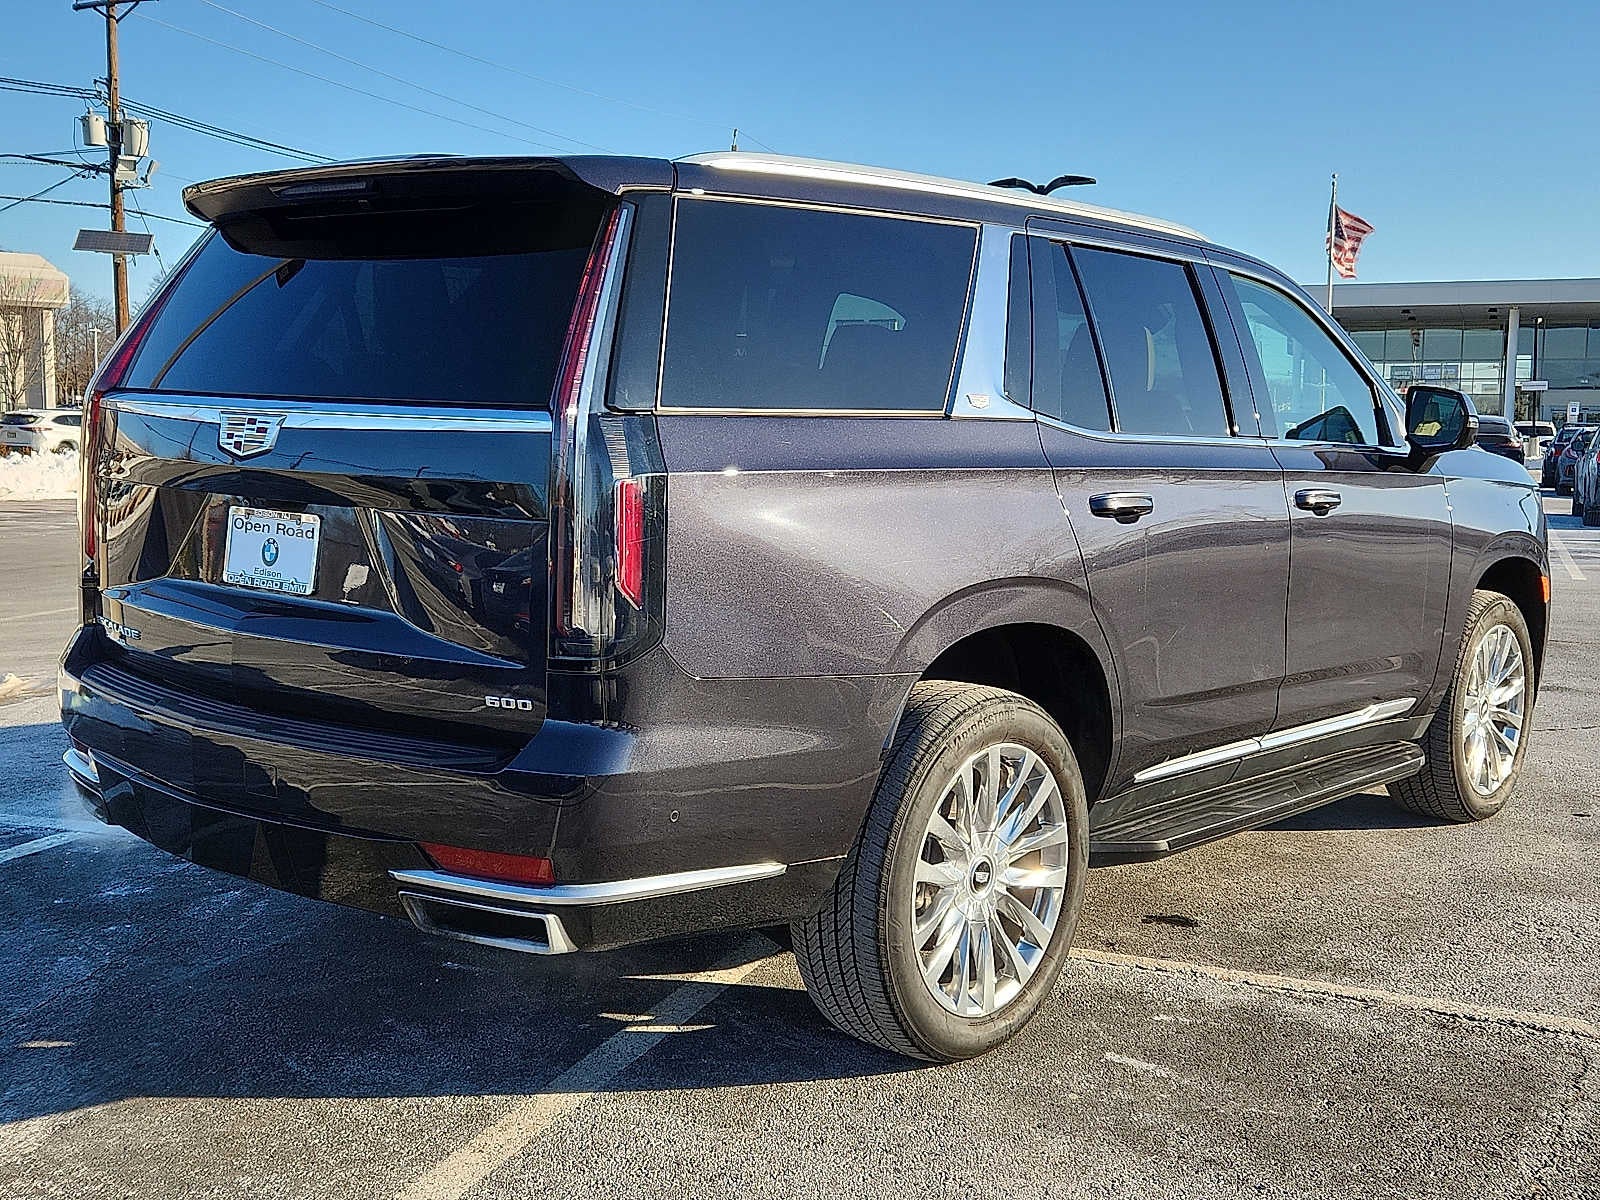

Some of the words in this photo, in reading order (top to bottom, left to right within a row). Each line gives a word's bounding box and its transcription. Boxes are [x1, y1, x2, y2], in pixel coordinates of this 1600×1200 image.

[234, 517, 271, 533] Open
[275, 523, 315, 539] Road
[253, 567, 282, 578] Edison
[228, 574, 253, 585] OPEN
[254, 580, 280, 588] ROAD
[282, 584, 306, 592] BMW
[485, 695, 532, 710] 600
